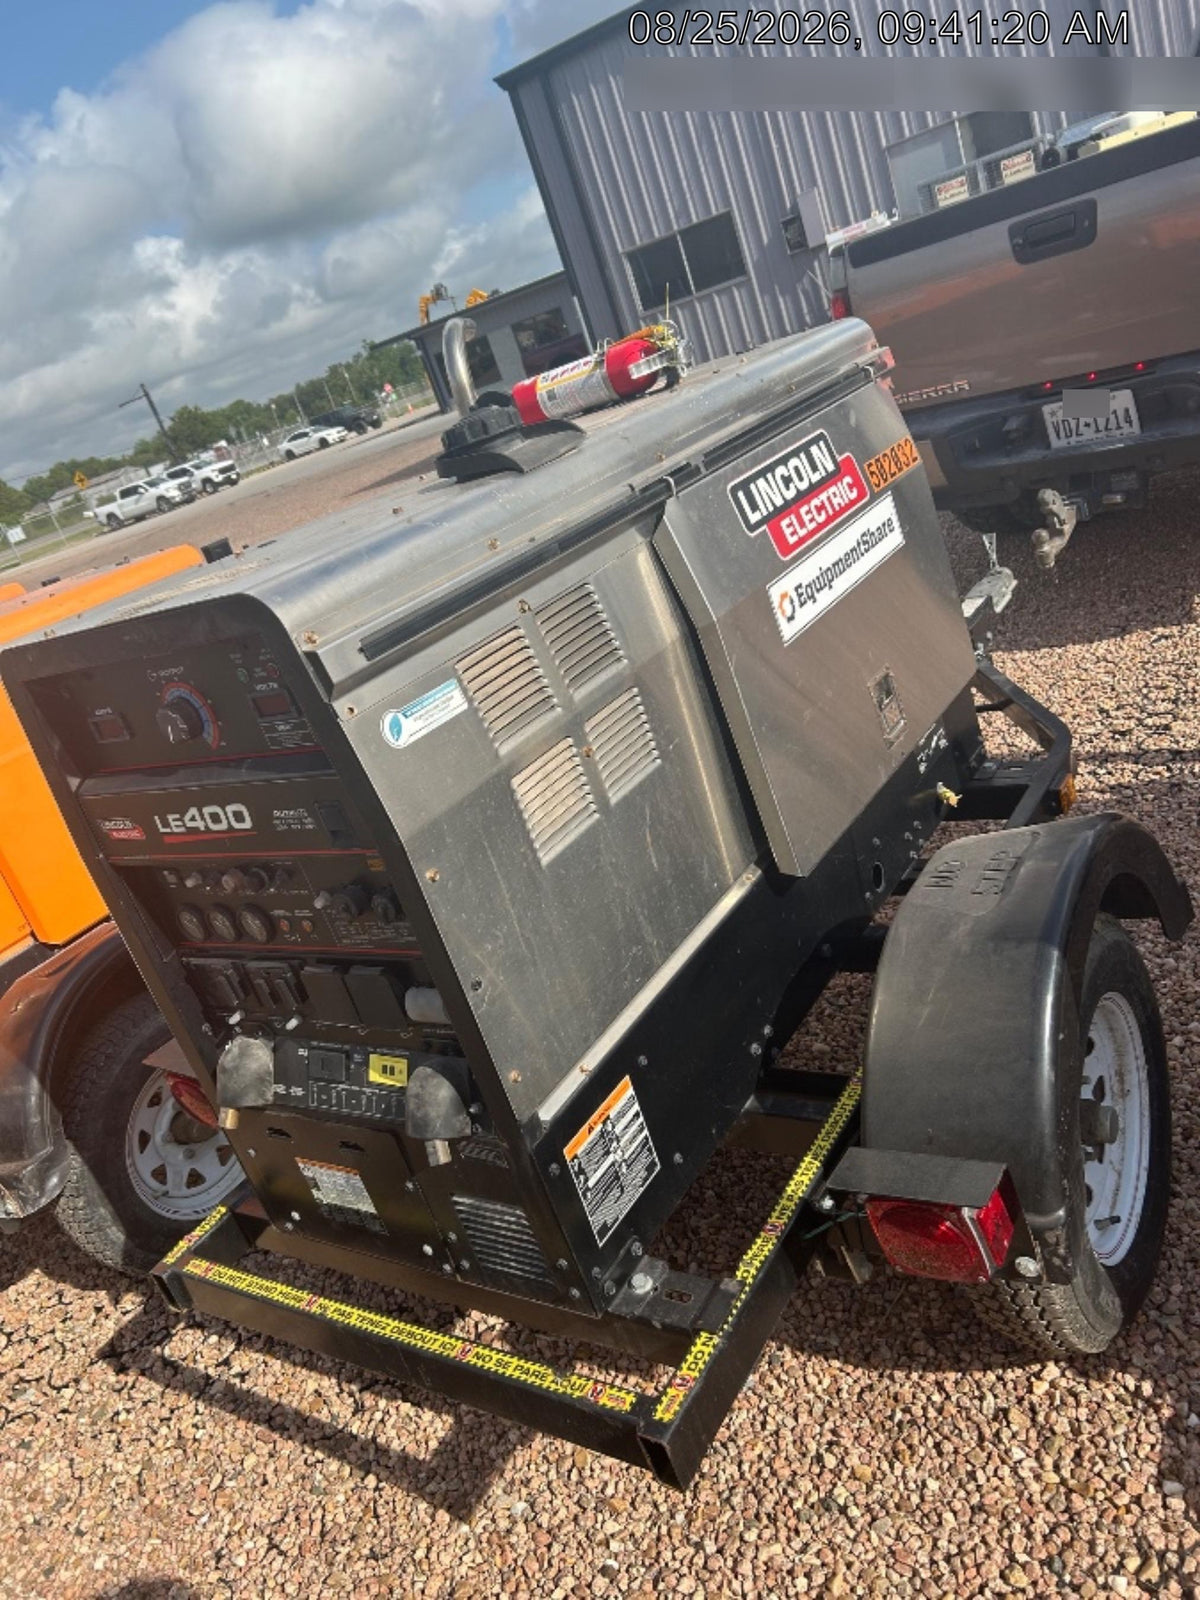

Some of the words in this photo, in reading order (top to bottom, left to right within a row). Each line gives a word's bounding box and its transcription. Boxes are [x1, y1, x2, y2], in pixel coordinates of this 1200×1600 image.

[737, 440, 836, 525] LINCOLN
[866, 439, 918, 489] 502032
[780, 475, 858, 545] ELECTRIC
[795, 516, 896, 608] EquipmentShare
[154, 803, 253, 833] LE400
[786, 1178, 806, 1203] PAS
[800, 1142, 826, 1179] TENEZ
[820, 1100, 851, 1144] DEBOUT
[213, 1268, 228, 1280] DO
[225, 1273, 247, 1287] NOT
[247, 1280, 277, 1294] STAND
[278, 1289, 306, 1303] HERE
[332, 1307, 351, 1320] PAS
[355, 1314, 390, 1332] TENEZ
[390, 1325, 438, 1347] DEBOUT
[439, 1339, 456, 1351] ICI
[472, 1349, 493, 1365] NO
[494, 1357, 511, 1370] SE
[513, 1362, 549, 1383] PARE
[686, 1350, 705, 1372] DO
